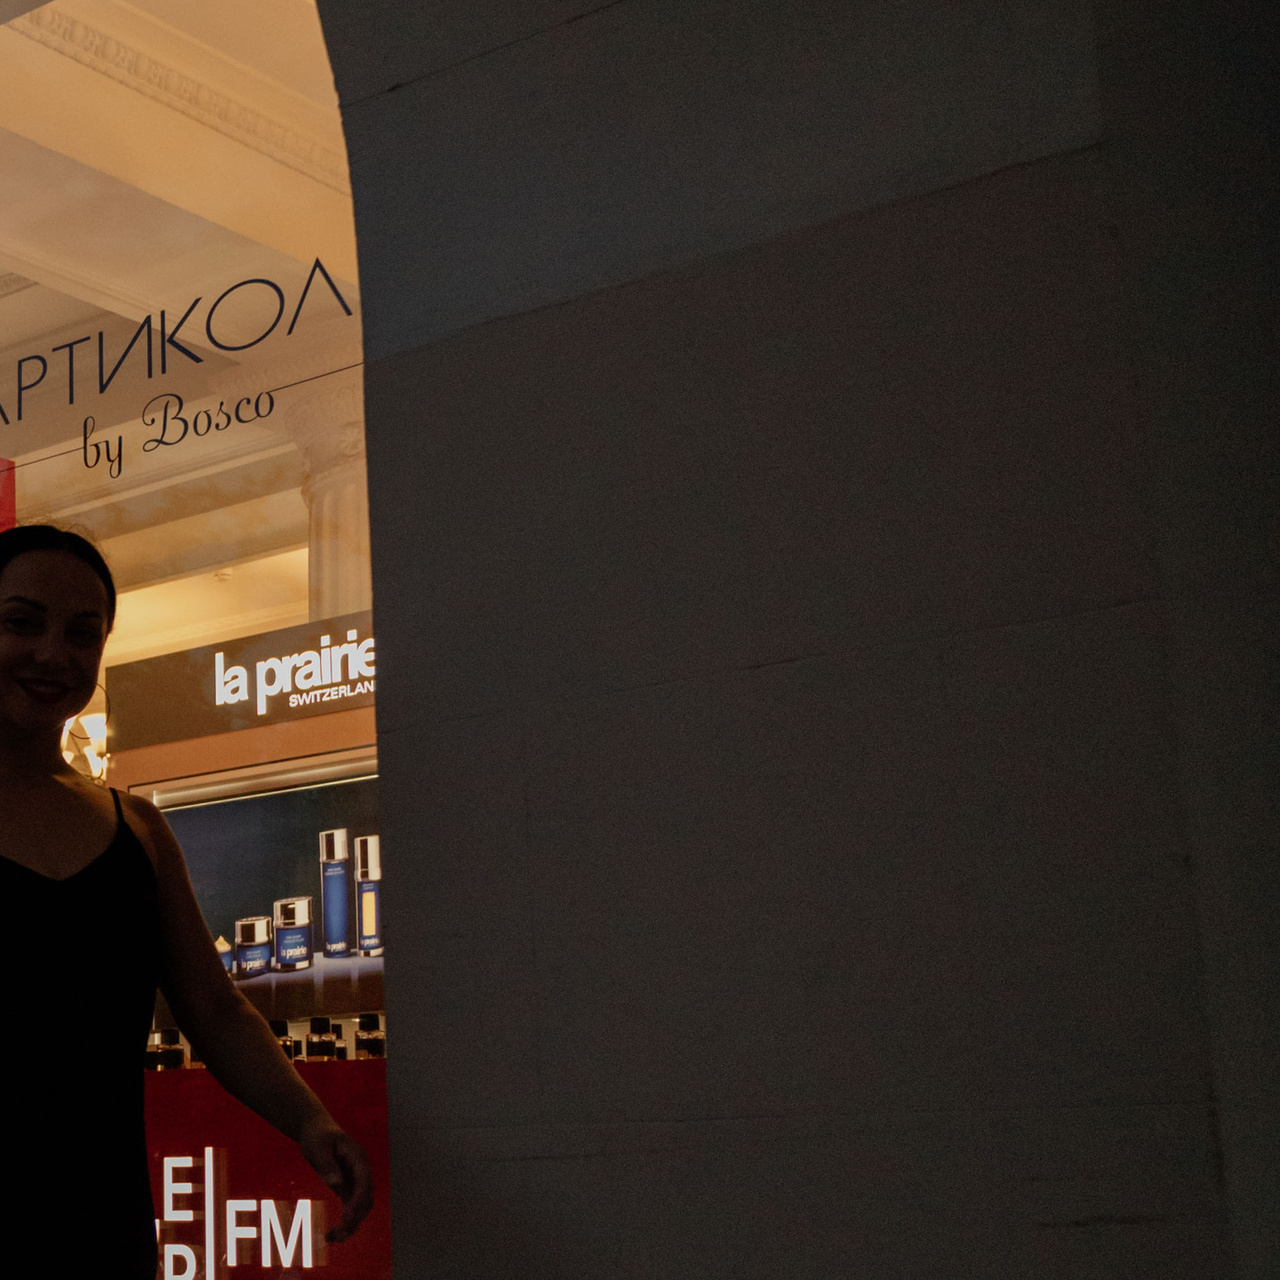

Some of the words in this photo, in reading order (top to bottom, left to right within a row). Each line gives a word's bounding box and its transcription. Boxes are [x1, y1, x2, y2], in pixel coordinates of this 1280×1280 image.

[83, 416, 122, 478] by
[142, 391, 275, 452] Bosco
[215, 652, 249, 706] la
[256, 629, 376, 716] prairie
[288, 680, 376, 708] SWITZERLAN
[226, 1199, 313, 1268] FM
